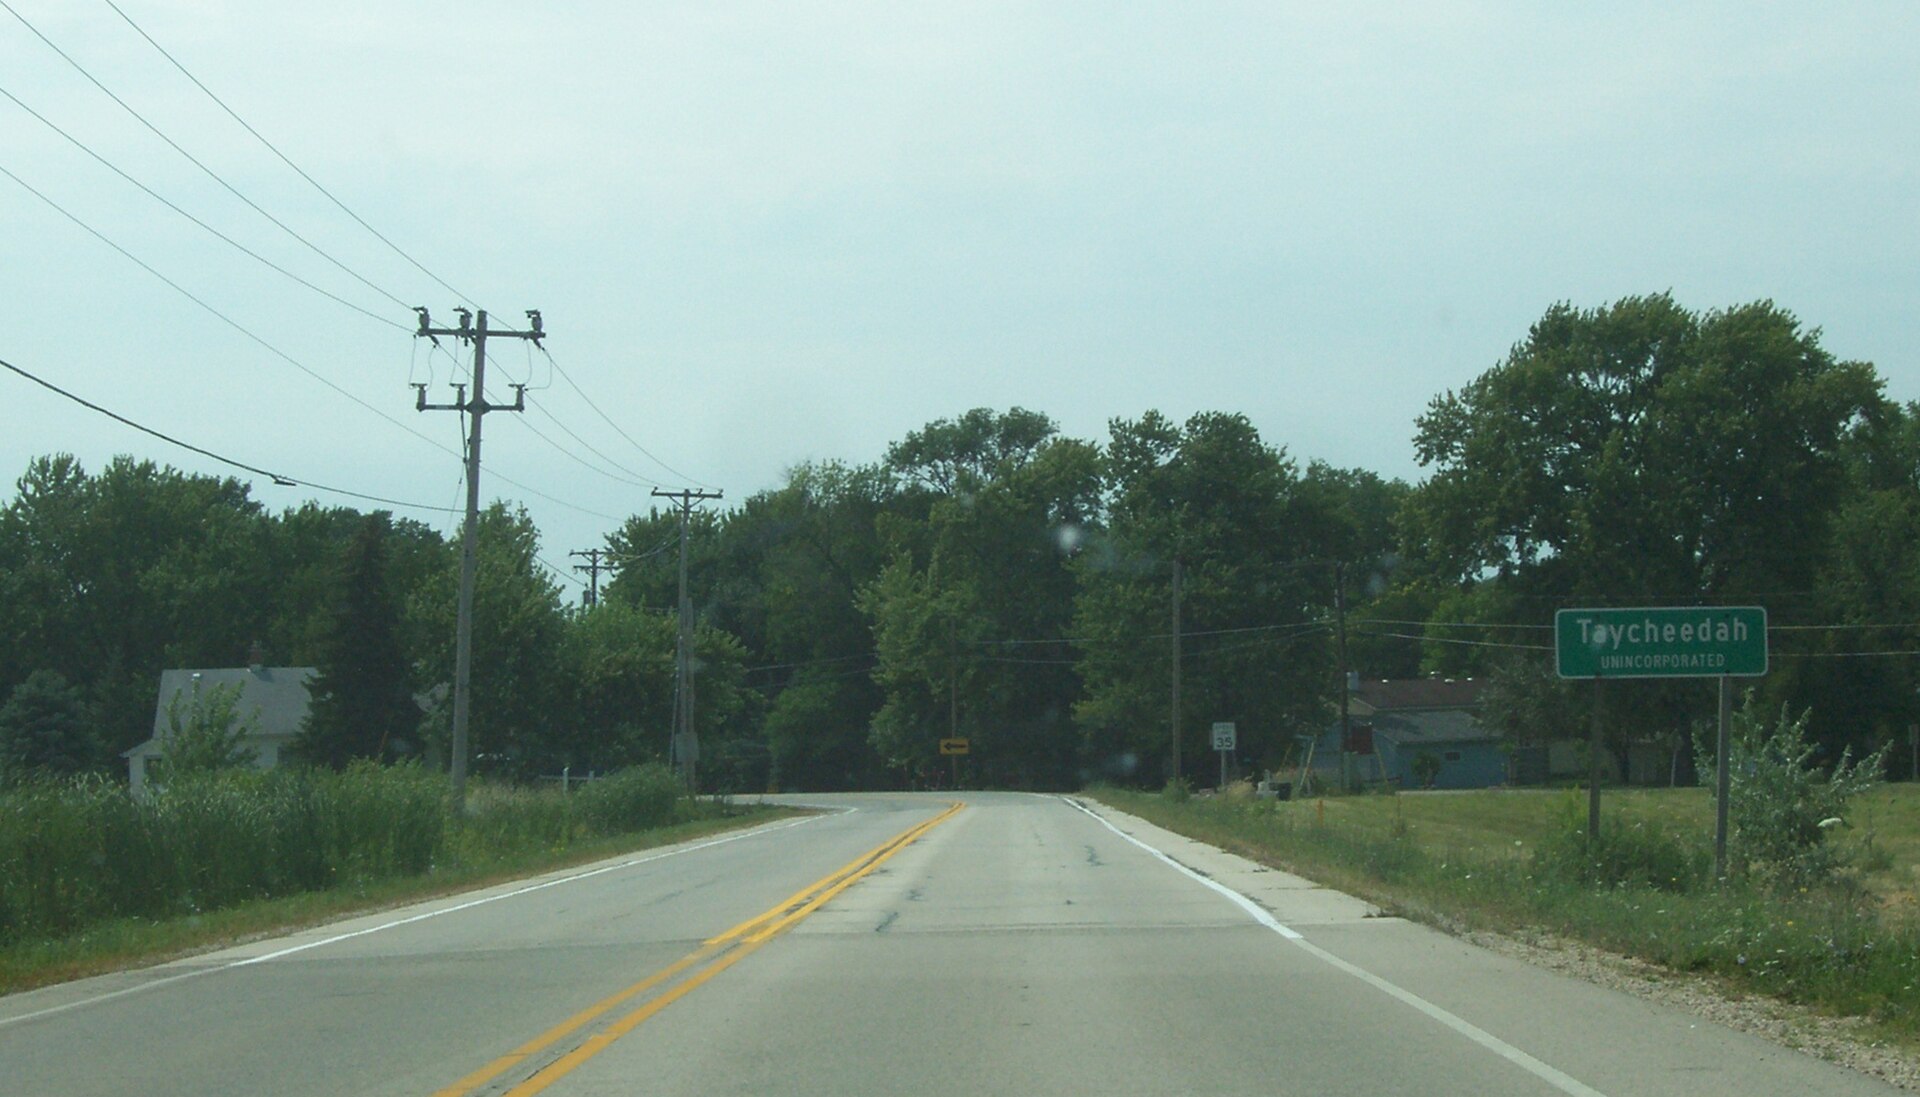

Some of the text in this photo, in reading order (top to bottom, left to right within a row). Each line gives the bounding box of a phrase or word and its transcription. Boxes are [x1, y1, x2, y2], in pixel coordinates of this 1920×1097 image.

[1576, 617, 1748, 650] Taycheedah
[1601, 653, 1726, 669] UNINCORPORATED
[1216, 736, 1233, 748] 35
